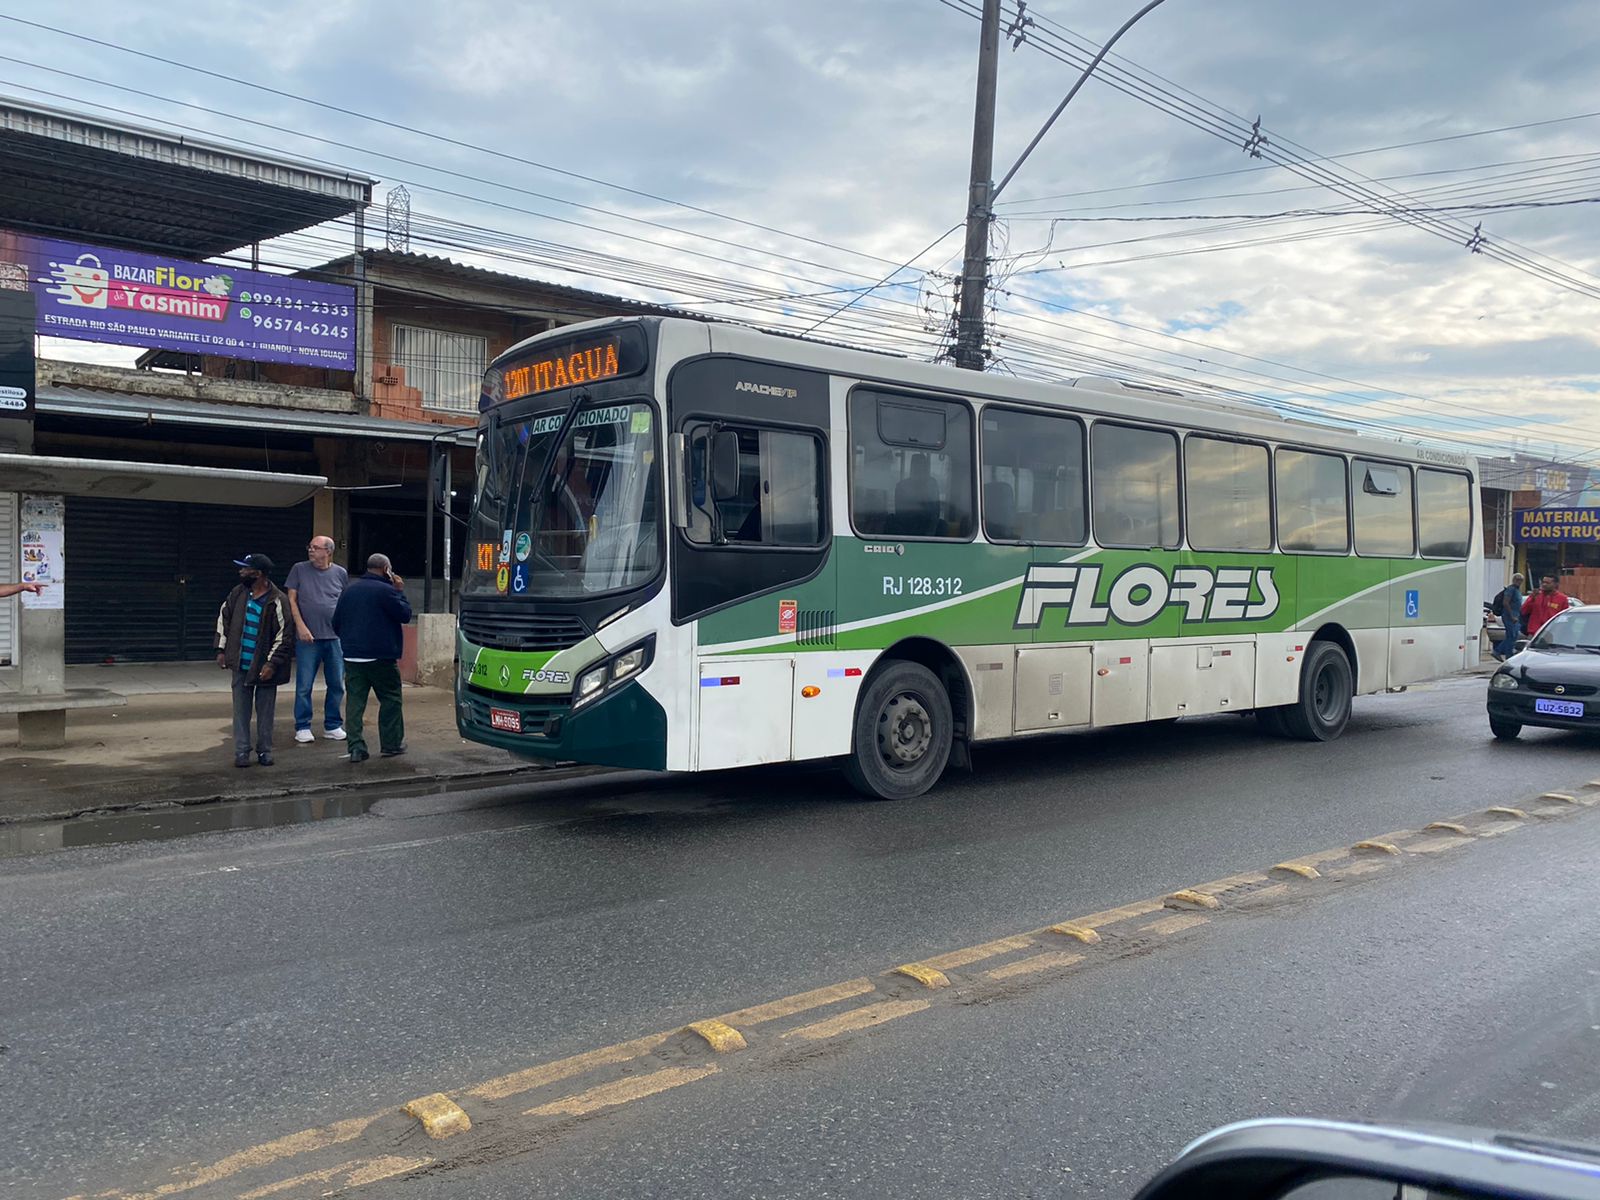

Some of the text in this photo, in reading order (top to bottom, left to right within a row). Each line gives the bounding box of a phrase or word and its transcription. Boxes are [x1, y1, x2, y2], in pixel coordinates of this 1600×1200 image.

[114, 264, 204, 291] BAZAR Flor
[113, 285, 220, 319] de Yasmim
[44, 314, 88, 328] ESTRADA
[90, 319, 106, 330] RIO
[107, 321, 126, 333] SÃO
[127, 325, 156, 336] PAULO
[158, 328, 200, 342] VARIANTE
[201, 334, 211, 343] LT
[212, 335, 224, 345] 02
[238, 338, 244, 347] 4
[299, 346, 319, 357] NOVA
[320, 349, 348, 360] IGUAÇU
[253, 314, 348, 339] 96574-6245
[533, 406, 629, 433] AR COICIONADO
[1416, 448, 1425, 459] AR
[1523, 511, 1599, 523] MATERIAL
[882, 576, 963, 596] RJ 128.312
[1013, 562, 1280, 630] FLORES
[521, 669, 572, 684] FLORES
